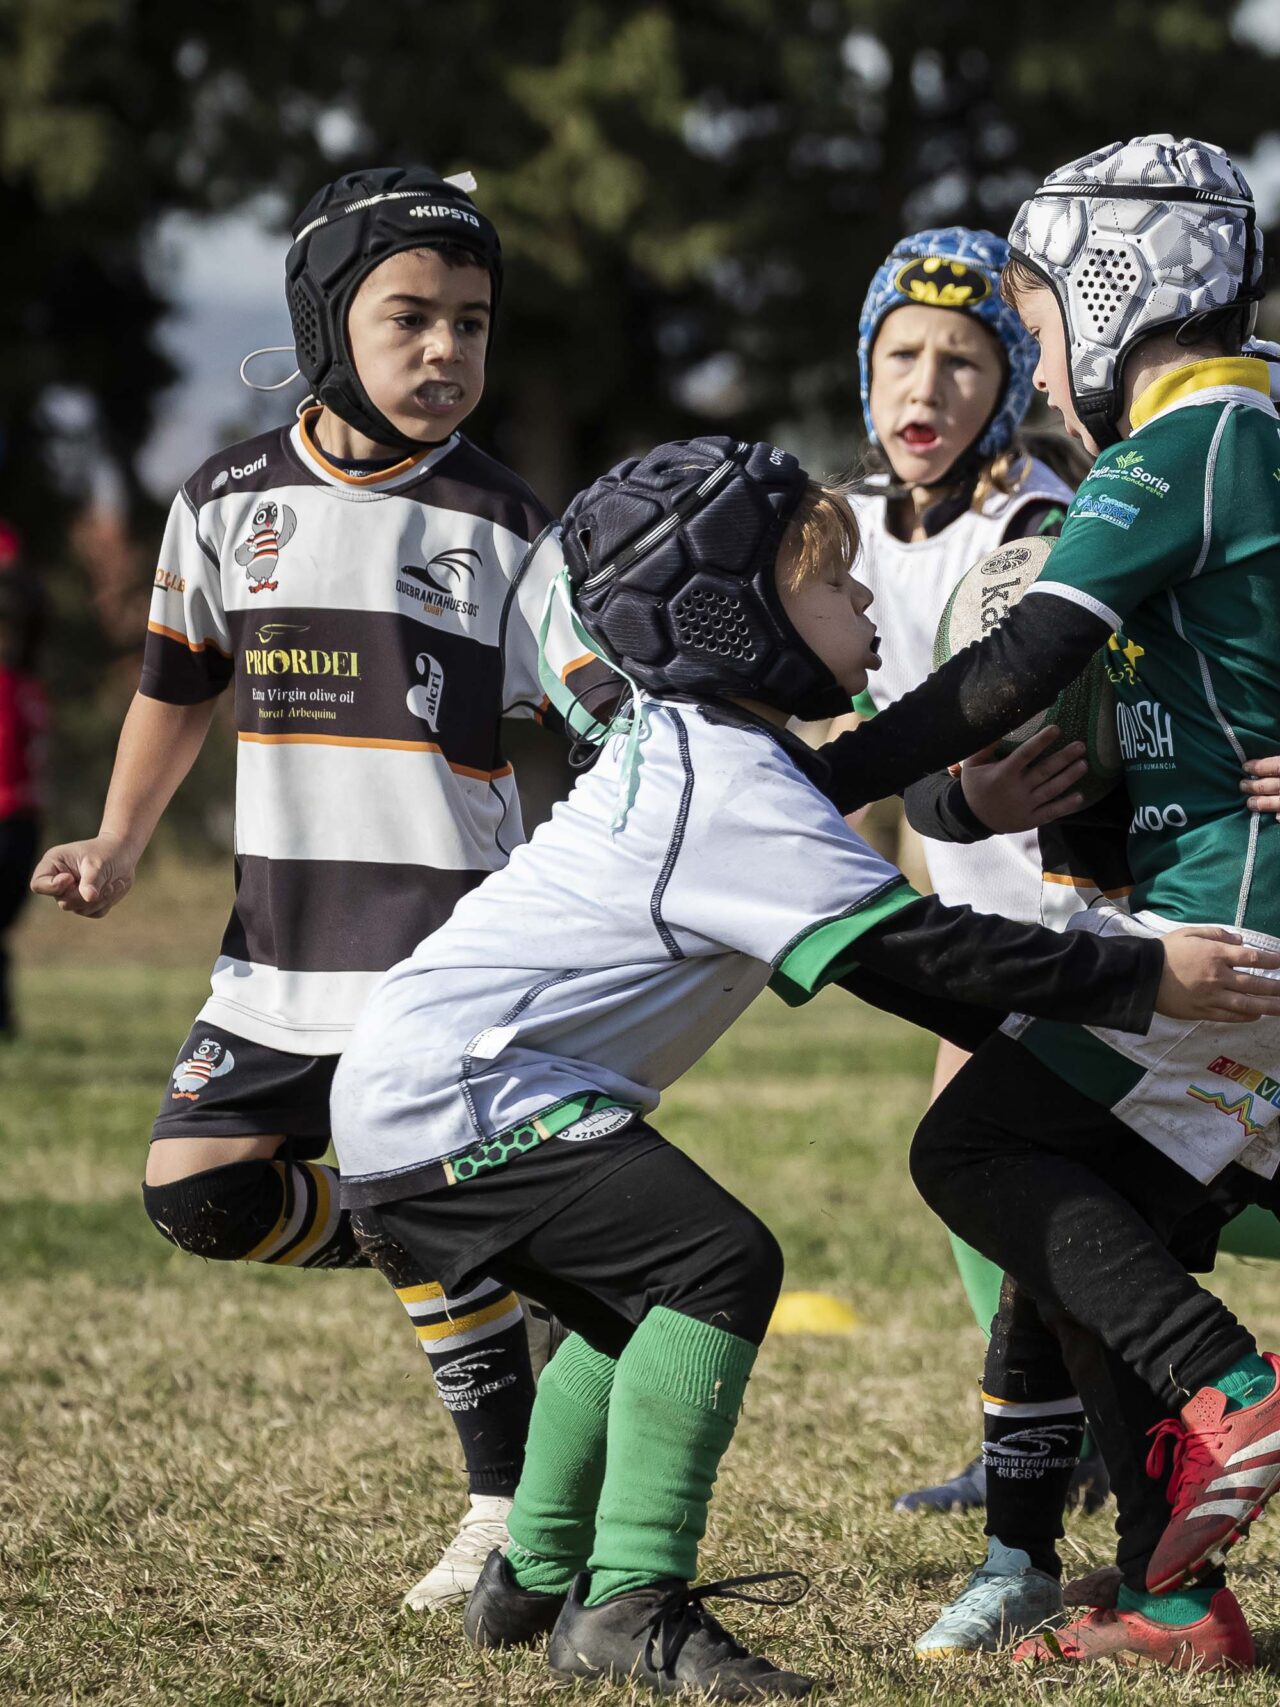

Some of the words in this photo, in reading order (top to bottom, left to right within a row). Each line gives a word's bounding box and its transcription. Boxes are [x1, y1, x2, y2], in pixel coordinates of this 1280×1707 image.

[231, 454, 267, 479] barri
[1130, 466, 1171, 493] Soria
[267, 687, 307, 703] Virgin
[309, 688, 337, 703] olive
[339, 690, 355, 704] oil
[288, 706, 337, 720] Arbequina
[997, 1466, 1045, 1480] RUGBY
